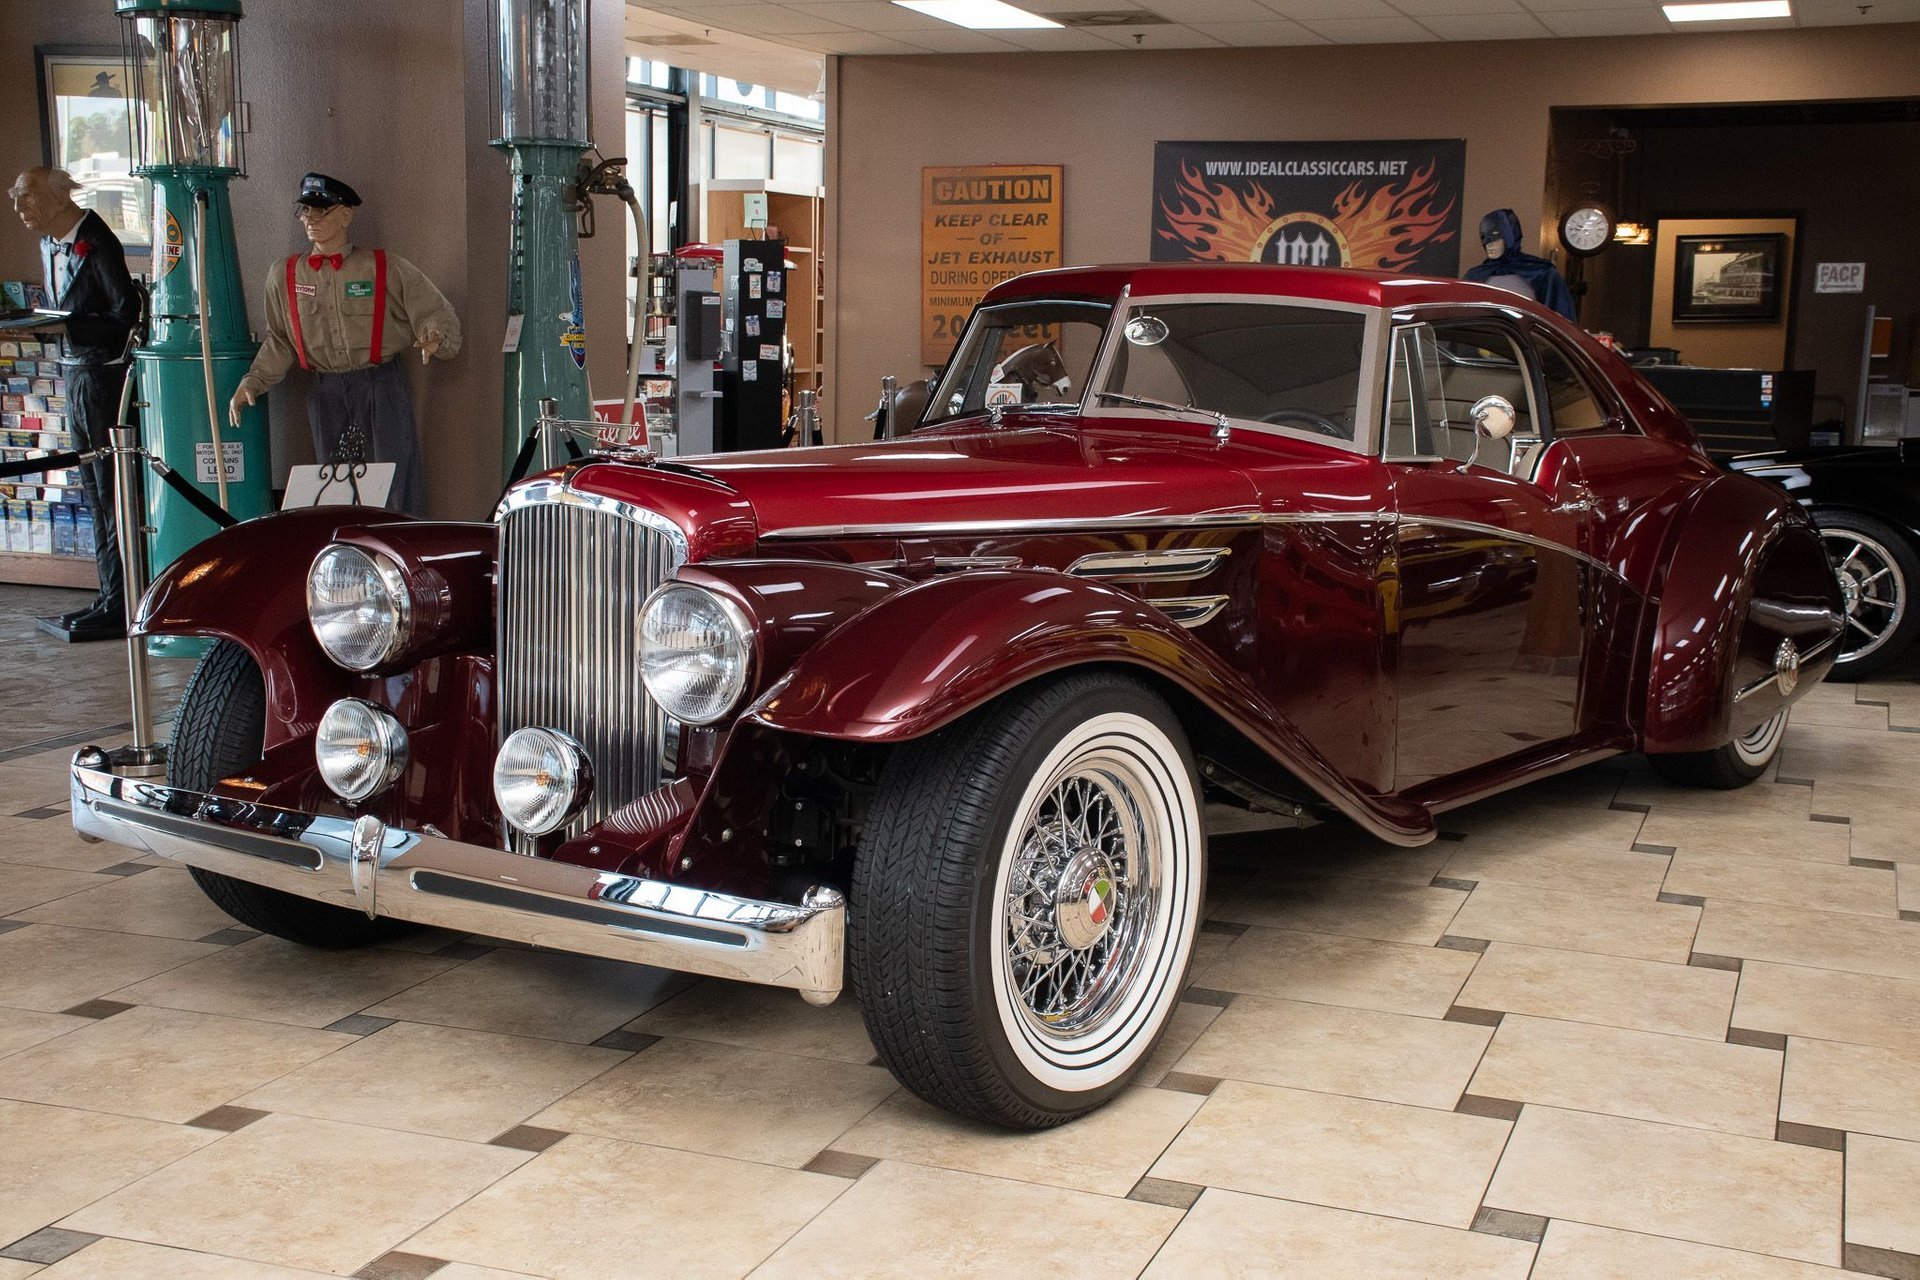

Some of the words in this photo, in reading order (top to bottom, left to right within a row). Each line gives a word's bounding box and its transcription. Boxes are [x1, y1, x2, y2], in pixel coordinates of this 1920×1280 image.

[1205, 161, 1408, 176] WWW.IDEALCLASSICCARS.NET
[935, 179, 1050, 201] CAUTION
[934, 213, 983, 228] KEEP
[988, 212, 1049, 227] CLEAR
[979, 233, 1005, 246] OF
[928, 251, 962, 265] JET
[968, 251, 1055, 265] EXHAUST
[930, 270, 978, 285] DURING
[1820, 265, 1861, 282] FACP
[929, 297, 973, 306] MINIMUM
